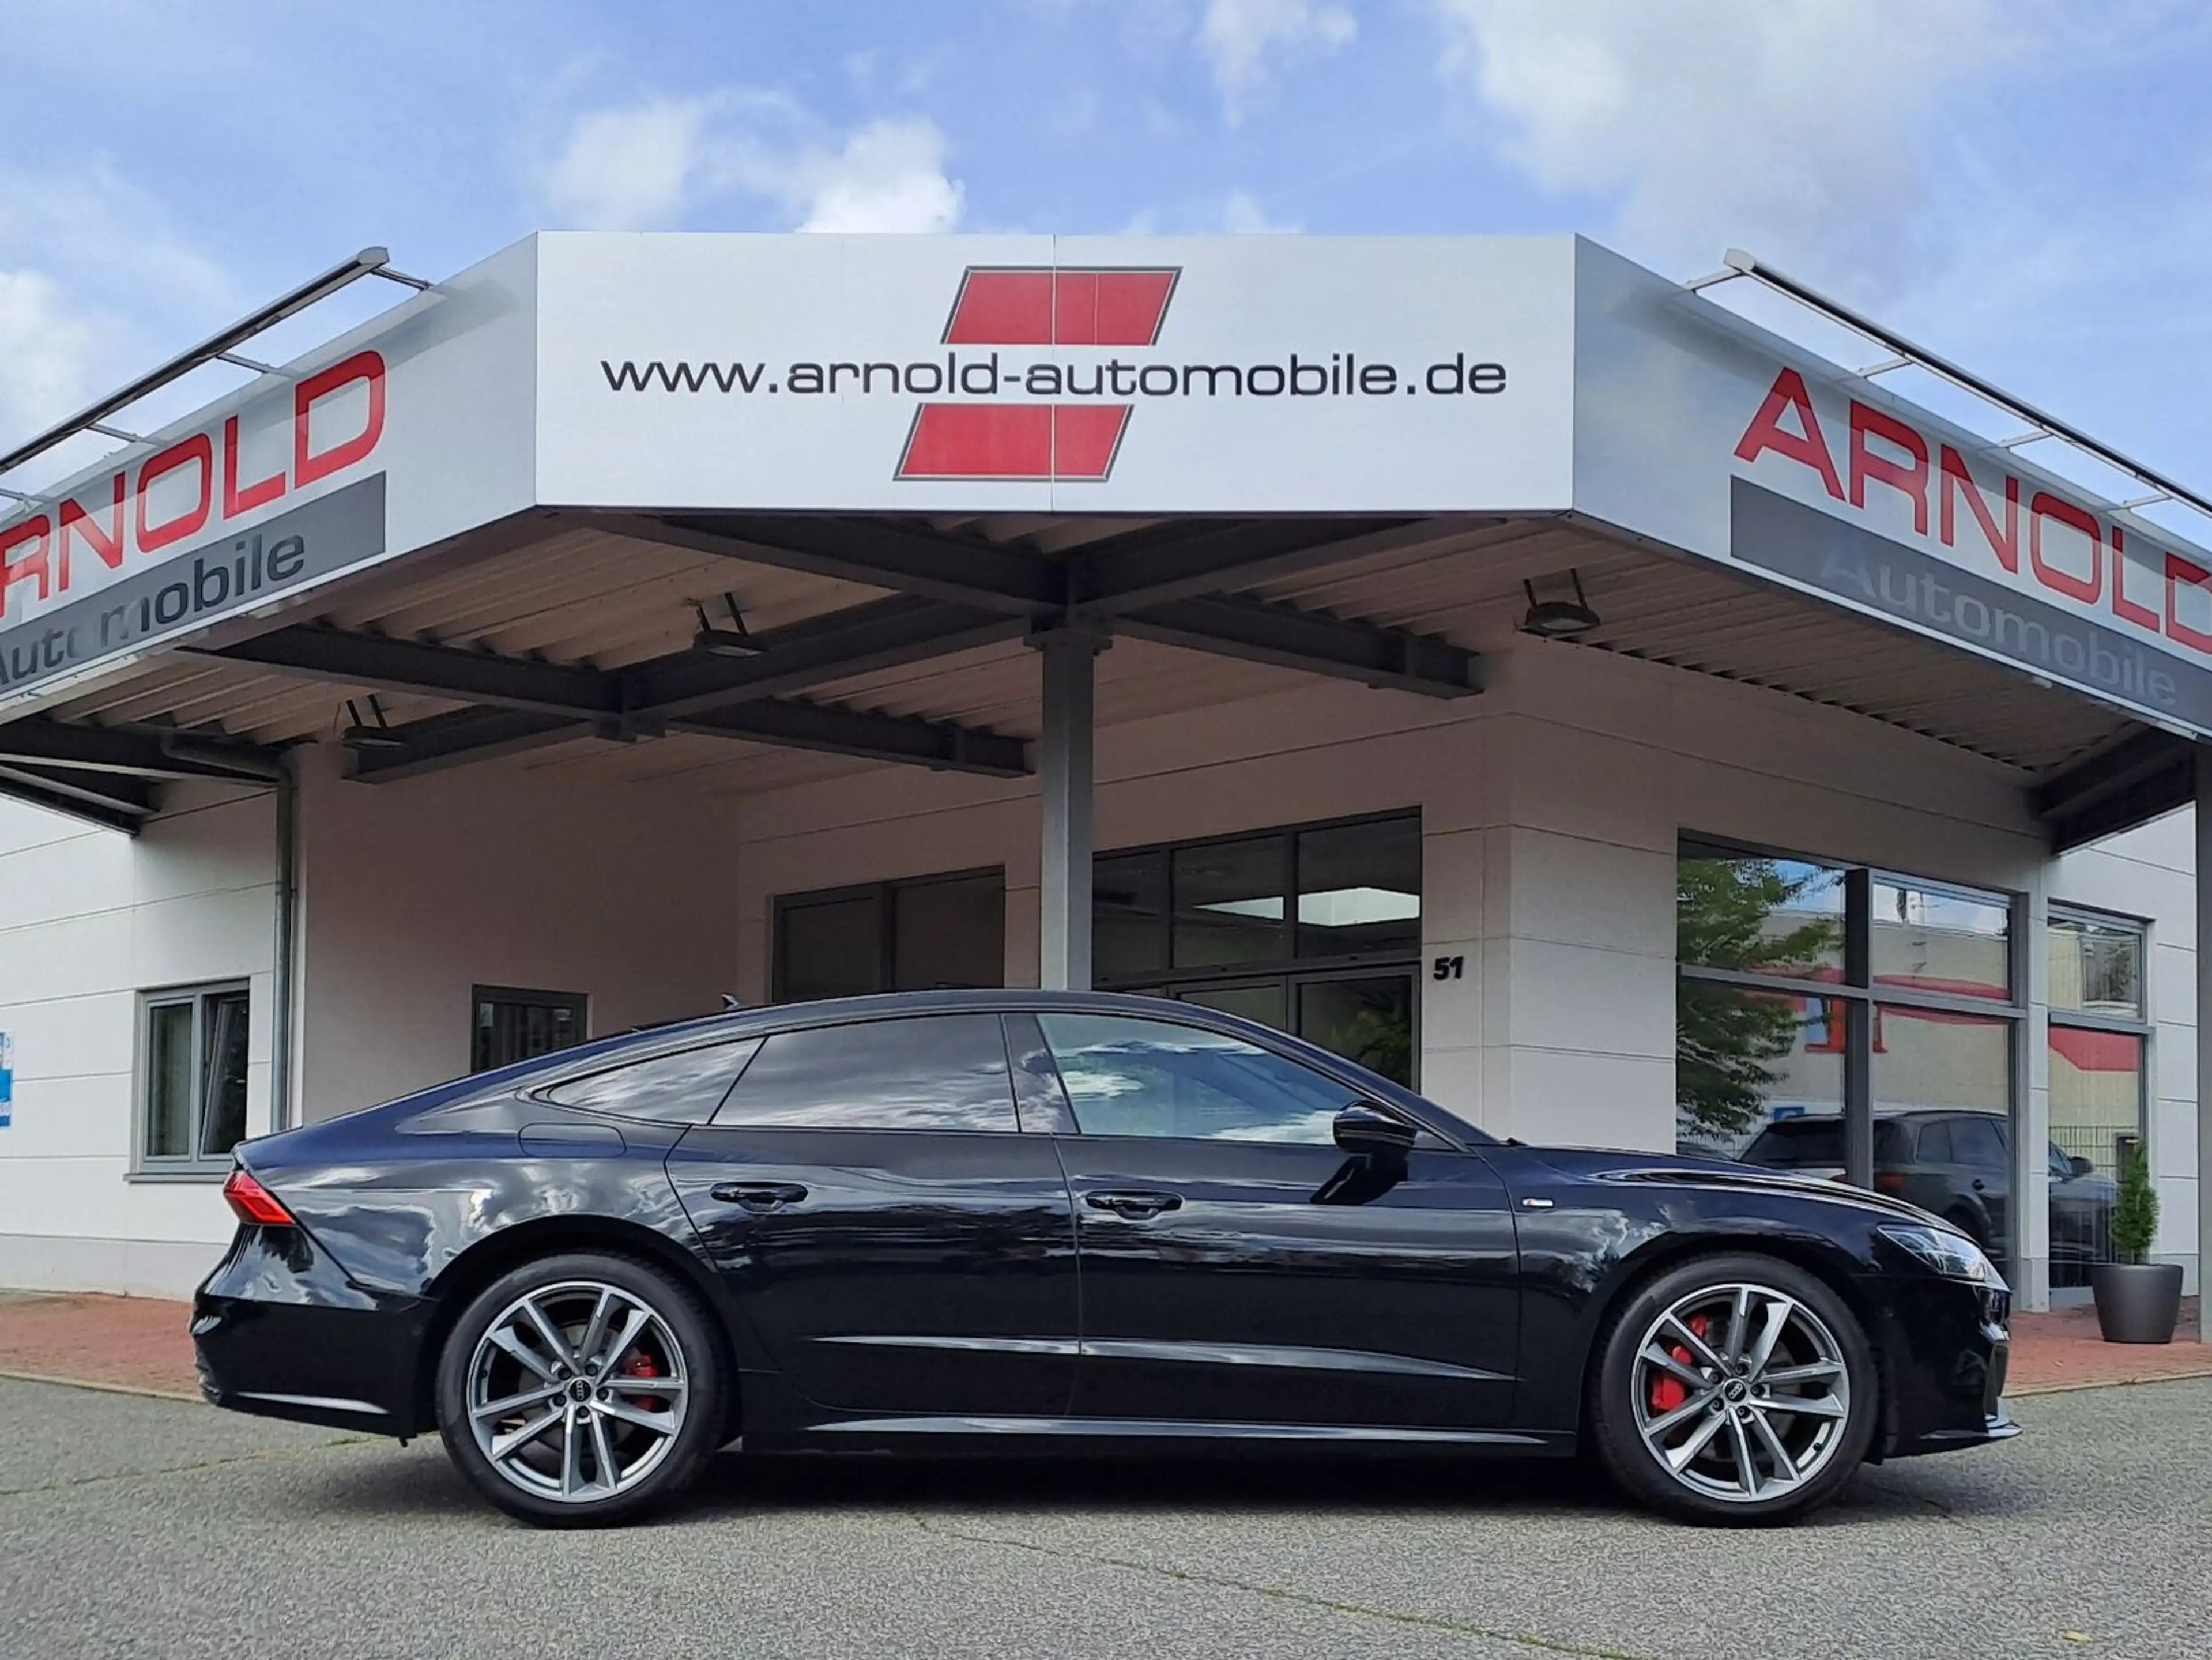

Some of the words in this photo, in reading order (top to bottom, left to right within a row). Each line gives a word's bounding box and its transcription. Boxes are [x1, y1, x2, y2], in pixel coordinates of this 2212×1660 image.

[601, 352, 1506, 397] www.arnold-automobile.de
[1734, 367, 2212, 655] ARNOLD
[0, 531, 304, 685] utmobile
[1819, 530, 2176, 705] Automobile
[1433, 955, 1464, 981] 51
